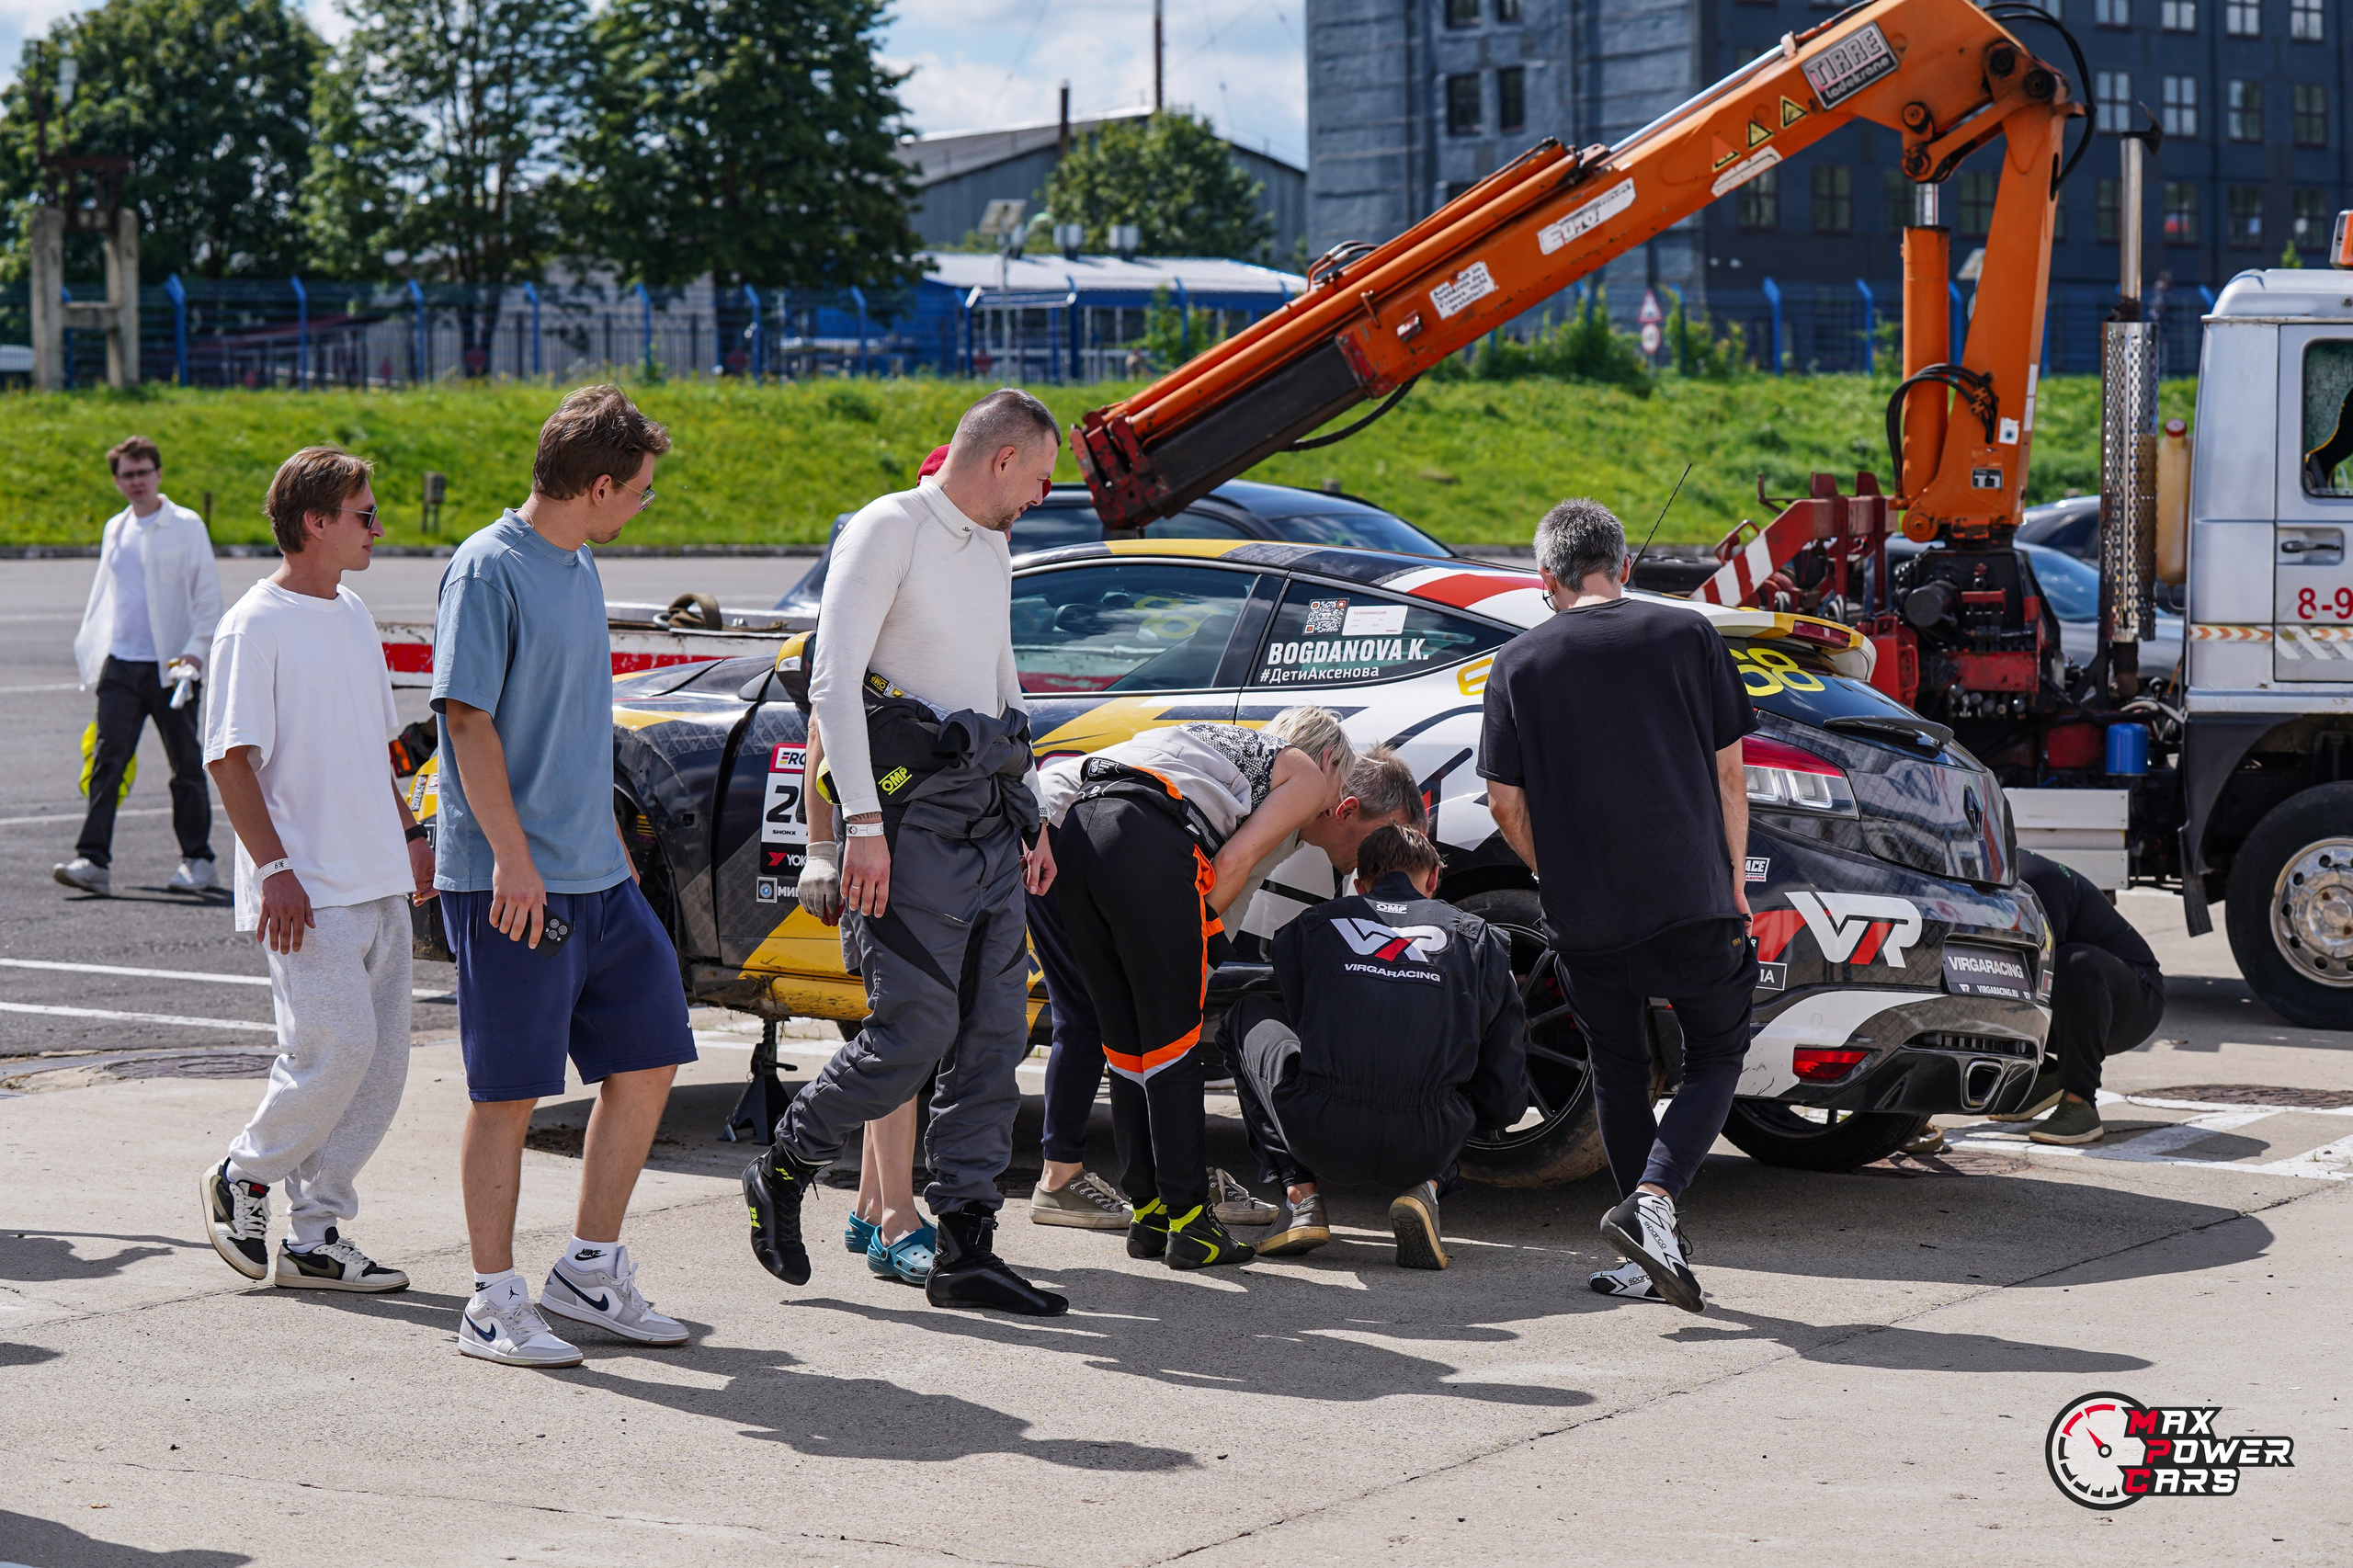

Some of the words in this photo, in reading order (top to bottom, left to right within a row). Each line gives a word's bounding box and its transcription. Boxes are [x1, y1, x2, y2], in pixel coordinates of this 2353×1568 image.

[1808, 30, 1881, 85] TIRRE
[1267, 639, 1403, 665] BOGDANOVA
[1407, 638, 1429, 661] K.
[1260, 666, 1380, 684] #ДетиАксенова
[881, 767, 908, 792] OMP
[1376, 903, 1407, 913] OMP
[1344, 963, 1441, 983] VIRGARACING
[1948, 956, 2025, 979] VIRGARACING
[1977, 985, 2019, 998] VIRGARACING.RU
[1644, 1221, 1667, 1250] sparco
[1628, 1274, 1651, 1285] sparc
